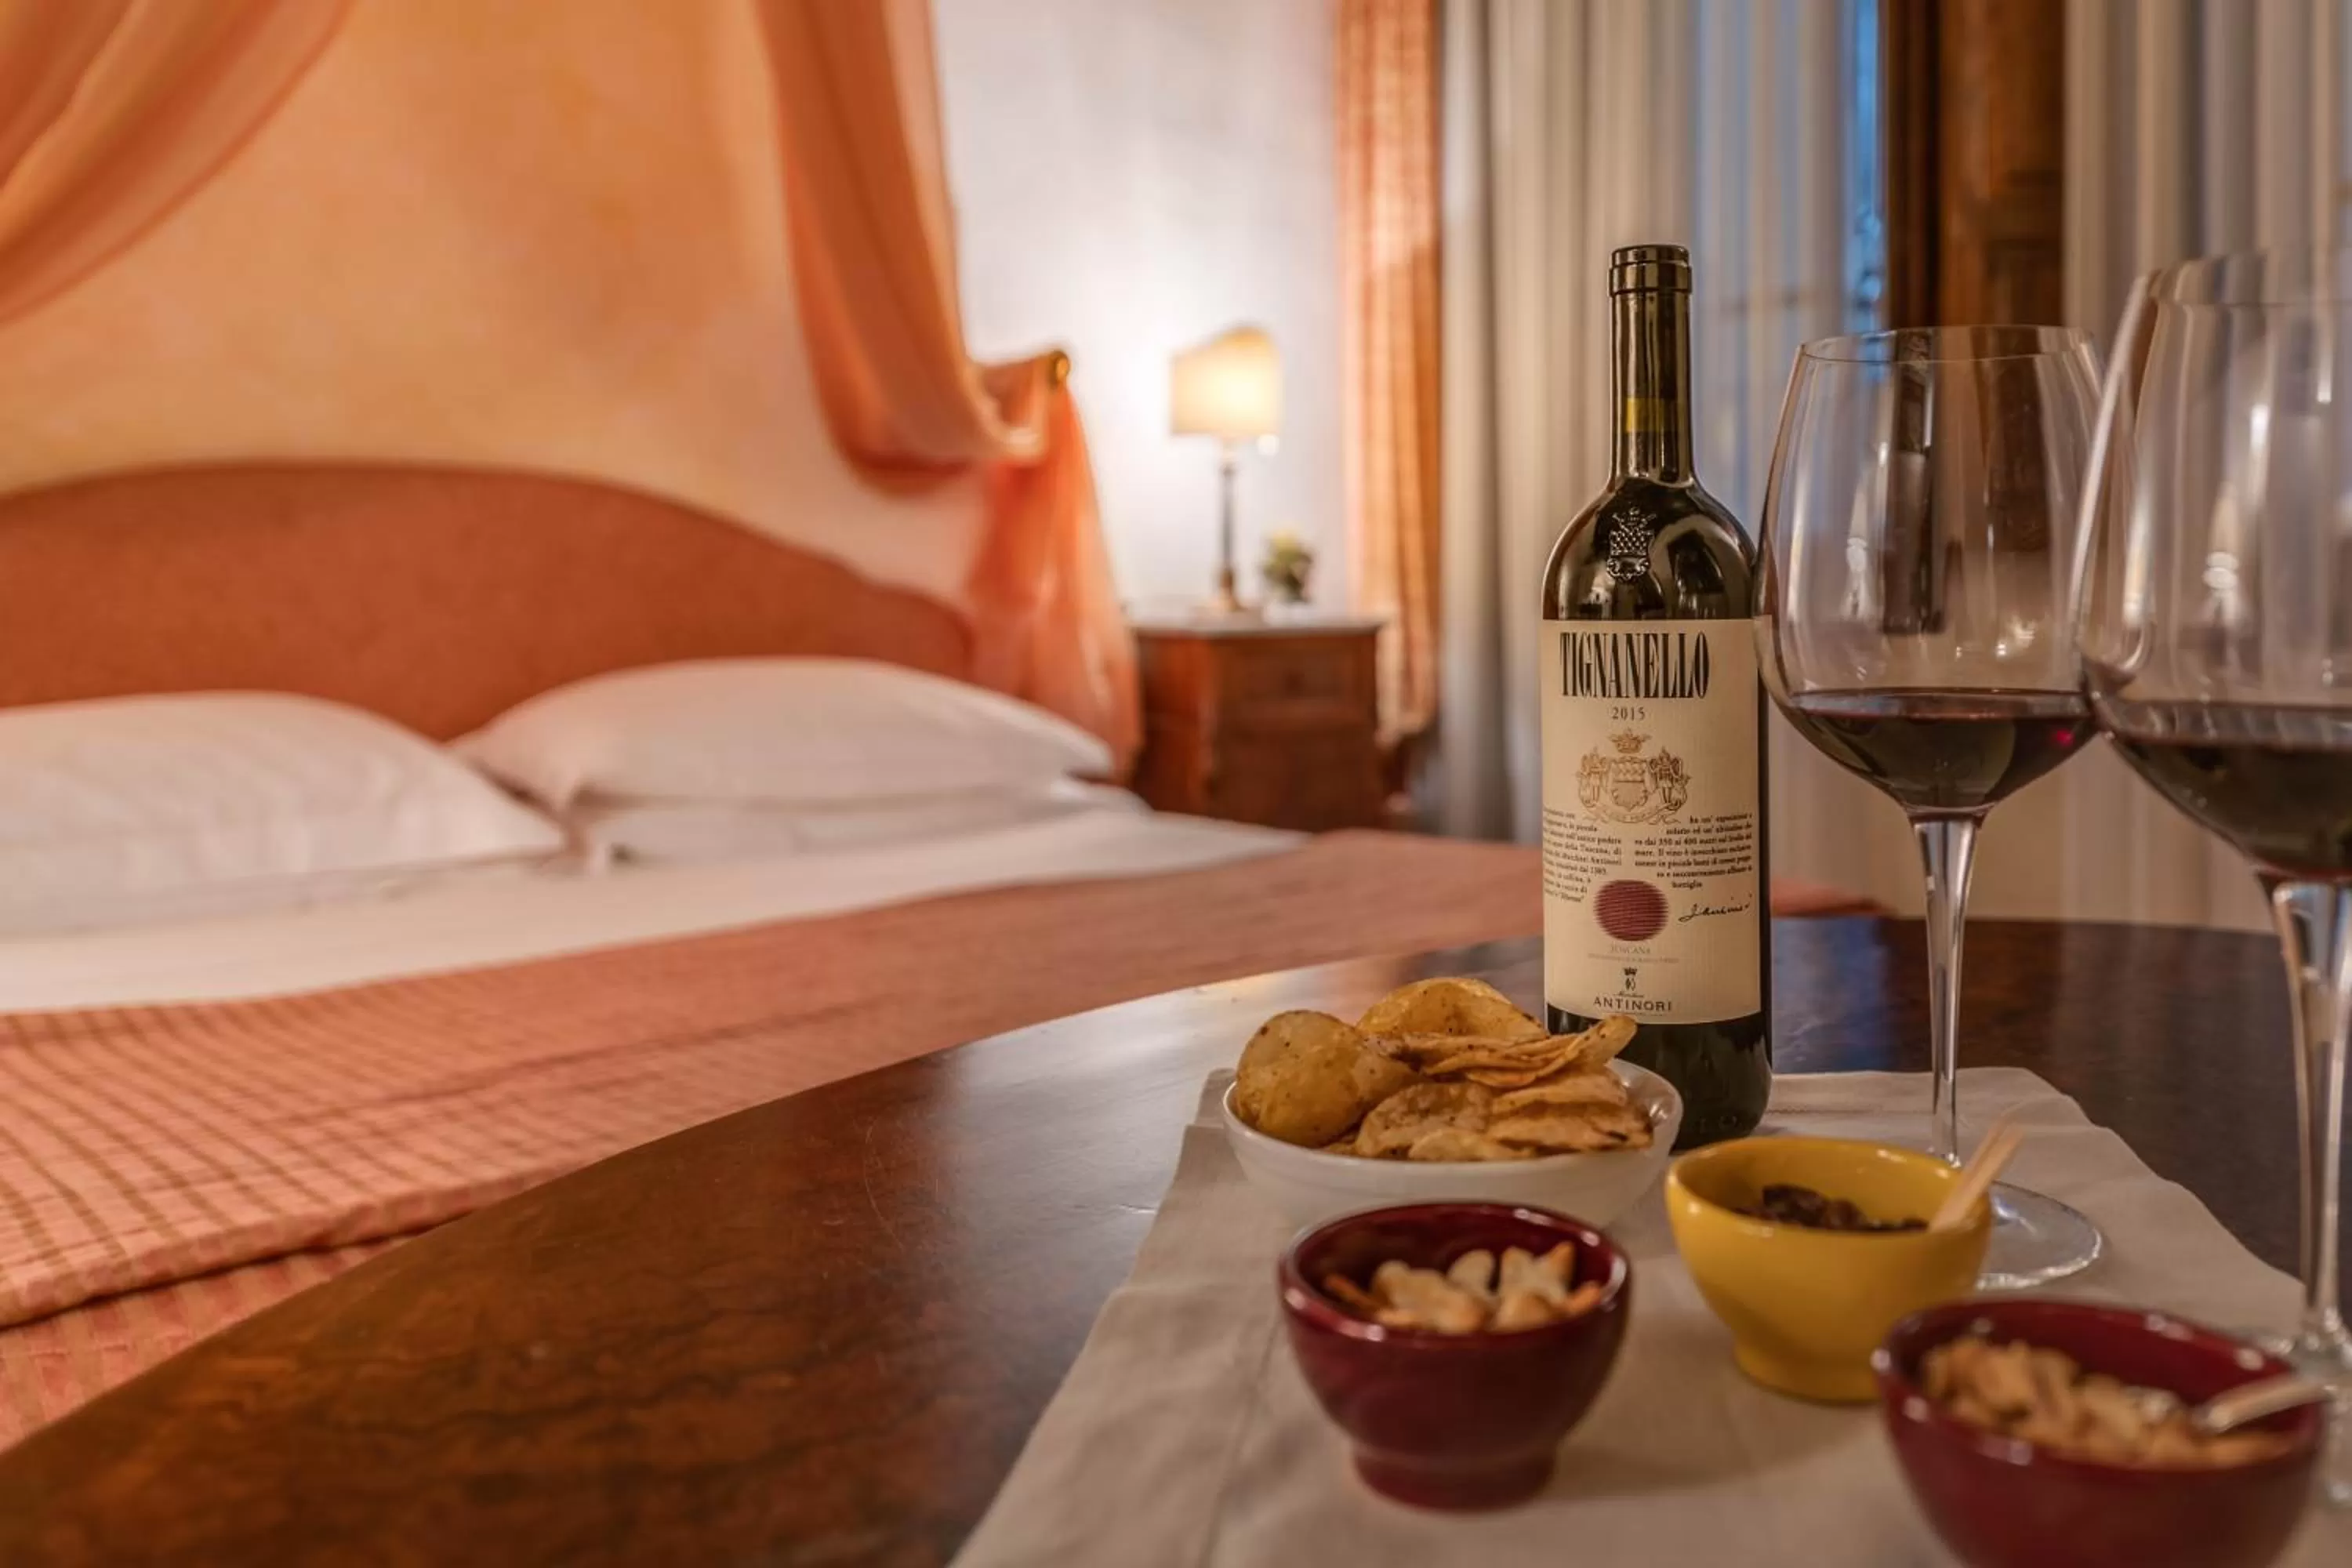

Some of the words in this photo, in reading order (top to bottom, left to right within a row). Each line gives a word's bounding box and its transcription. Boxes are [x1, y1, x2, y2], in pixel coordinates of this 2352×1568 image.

[1560, 631, 1709, 699] TIGNANELLO
[1612, 706, 1645, 720] 2015
[1593, 996, 1672, 1011] ANTINORI
